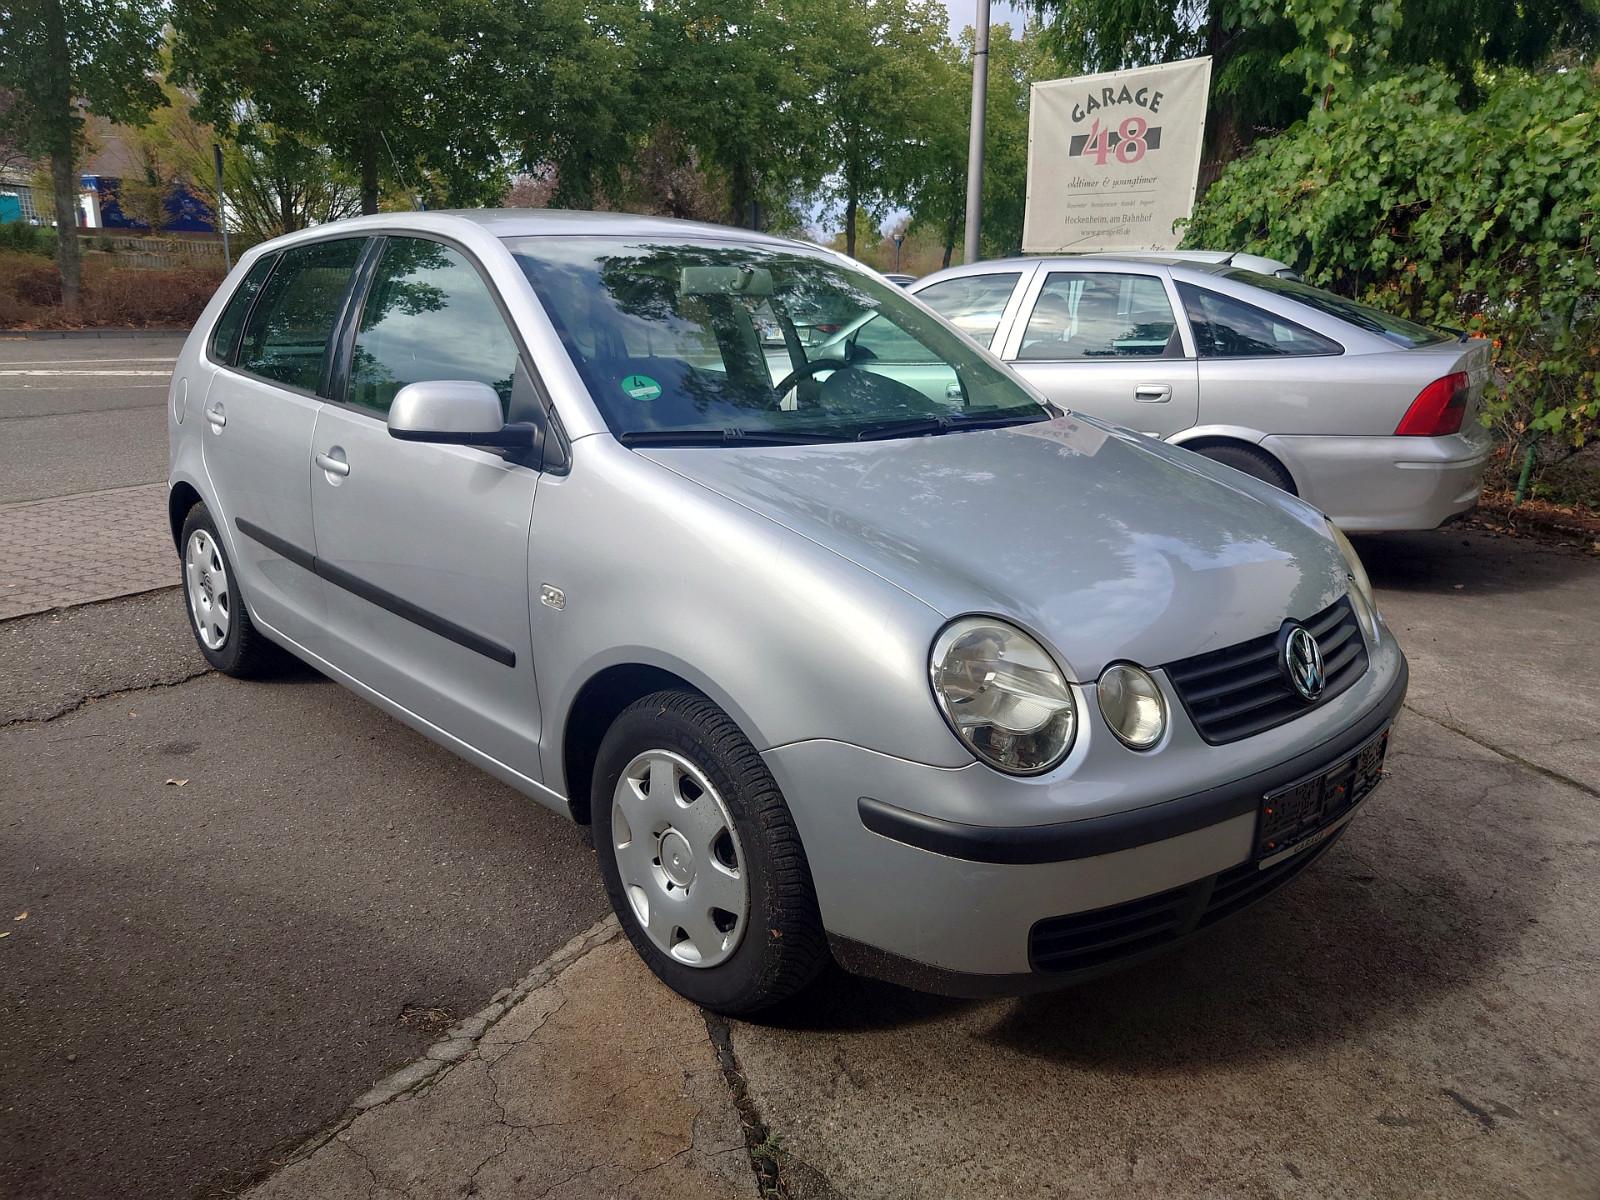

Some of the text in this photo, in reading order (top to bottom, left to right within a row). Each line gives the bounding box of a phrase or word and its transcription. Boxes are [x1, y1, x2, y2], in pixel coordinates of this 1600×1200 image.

[1071, 83, 1164, 123] GARAGE
[1082, 117, 1148, 165] 48
[1067, 175, 1158, 189] oldtimer & youngtimer
[1109, 216, 1121, 224] am
[1121, 213, 1153, 223] Bahnhof
[633, 376, 645, 387] 4
